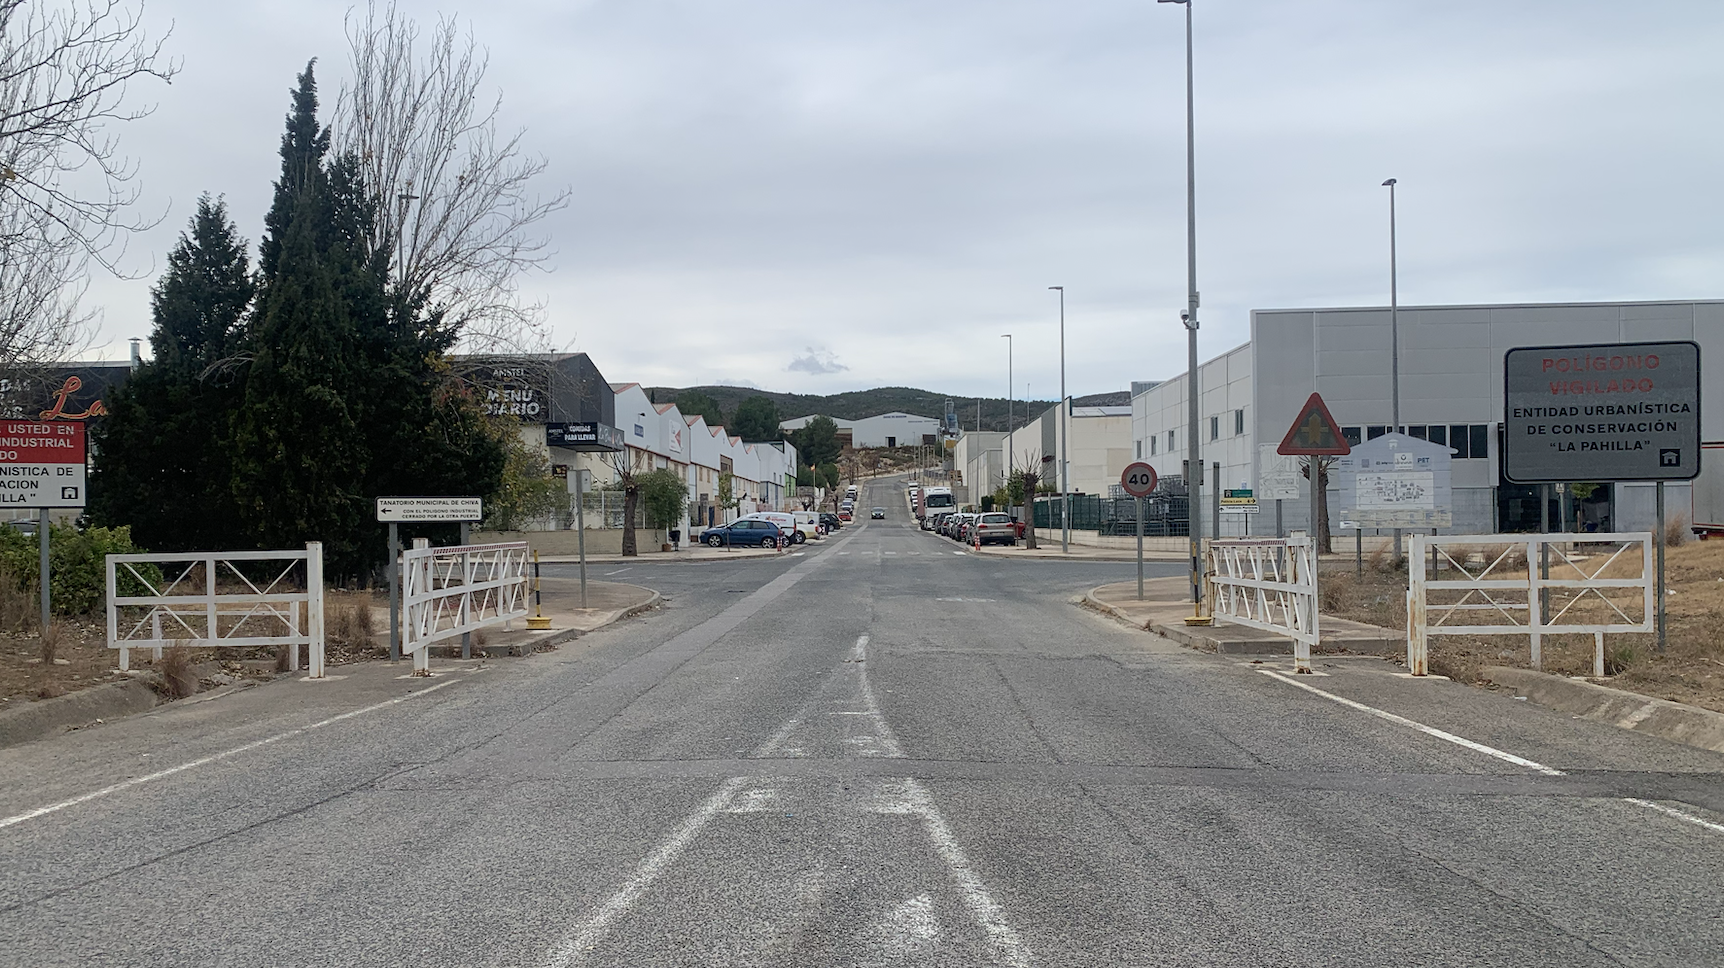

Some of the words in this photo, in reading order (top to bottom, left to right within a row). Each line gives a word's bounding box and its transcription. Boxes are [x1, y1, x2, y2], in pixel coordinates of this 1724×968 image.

[1542, 354, 1660, 372] POLÍGONO
[487, 385, 533, 402] MENÚ
[1550, 378, 1654, 395] VIGILADO
[1513, 406, 1579, 418] ENTIDAD
[1585, 402, 1691, 416] URBANÍSTICA
[8, 424, 50, 434] USTED
[57, 426, 74, 435] EN
[1527, 424, 1546, 435] DE
[1551, 419, 1677, 435] CONSERVACIÓN
[57, 467, 73, 476] DE
[1128, 473, 1149, 485] 40
